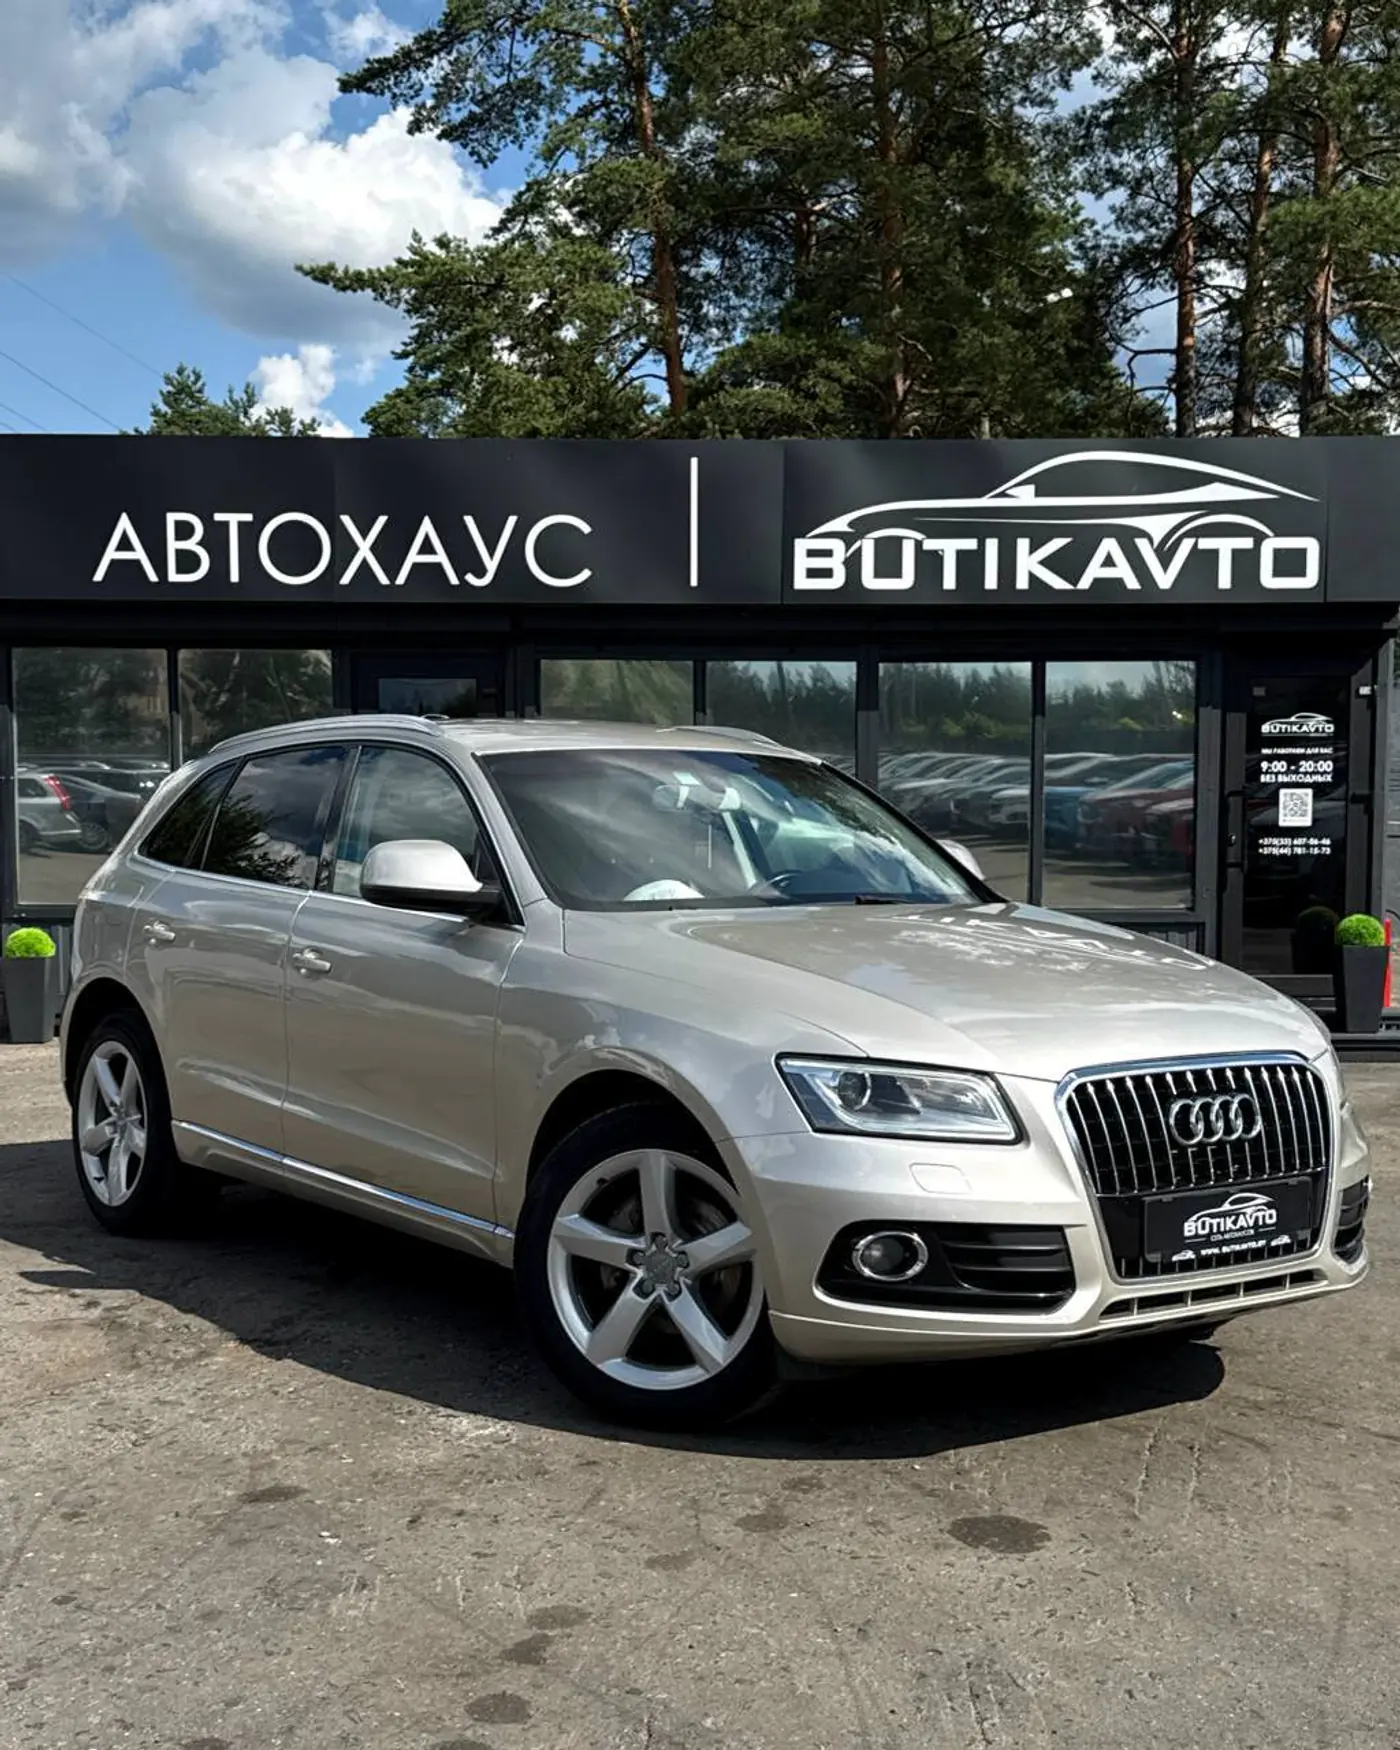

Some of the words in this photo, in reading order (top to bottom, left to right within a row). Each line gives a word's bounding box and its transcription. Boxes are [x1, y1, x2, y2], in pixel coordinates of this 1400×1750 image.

[92, 511, 593, 587] АВТОХАУС
[793, 536, 1320, 590] BUTIKAVTO
[1260, 723, 1335, 733] BUTIKAVTO
[1260, 760, 1288, 773] 9:00
[1298, 760, 1334, 773] 20:00
[1260, 774, 1276, 784] БЕЗ
[1277, 773, 1333, 784] ВЫХОДНЫХ
[1184, 1209, 1277, 1237] BUTIKAVTO
